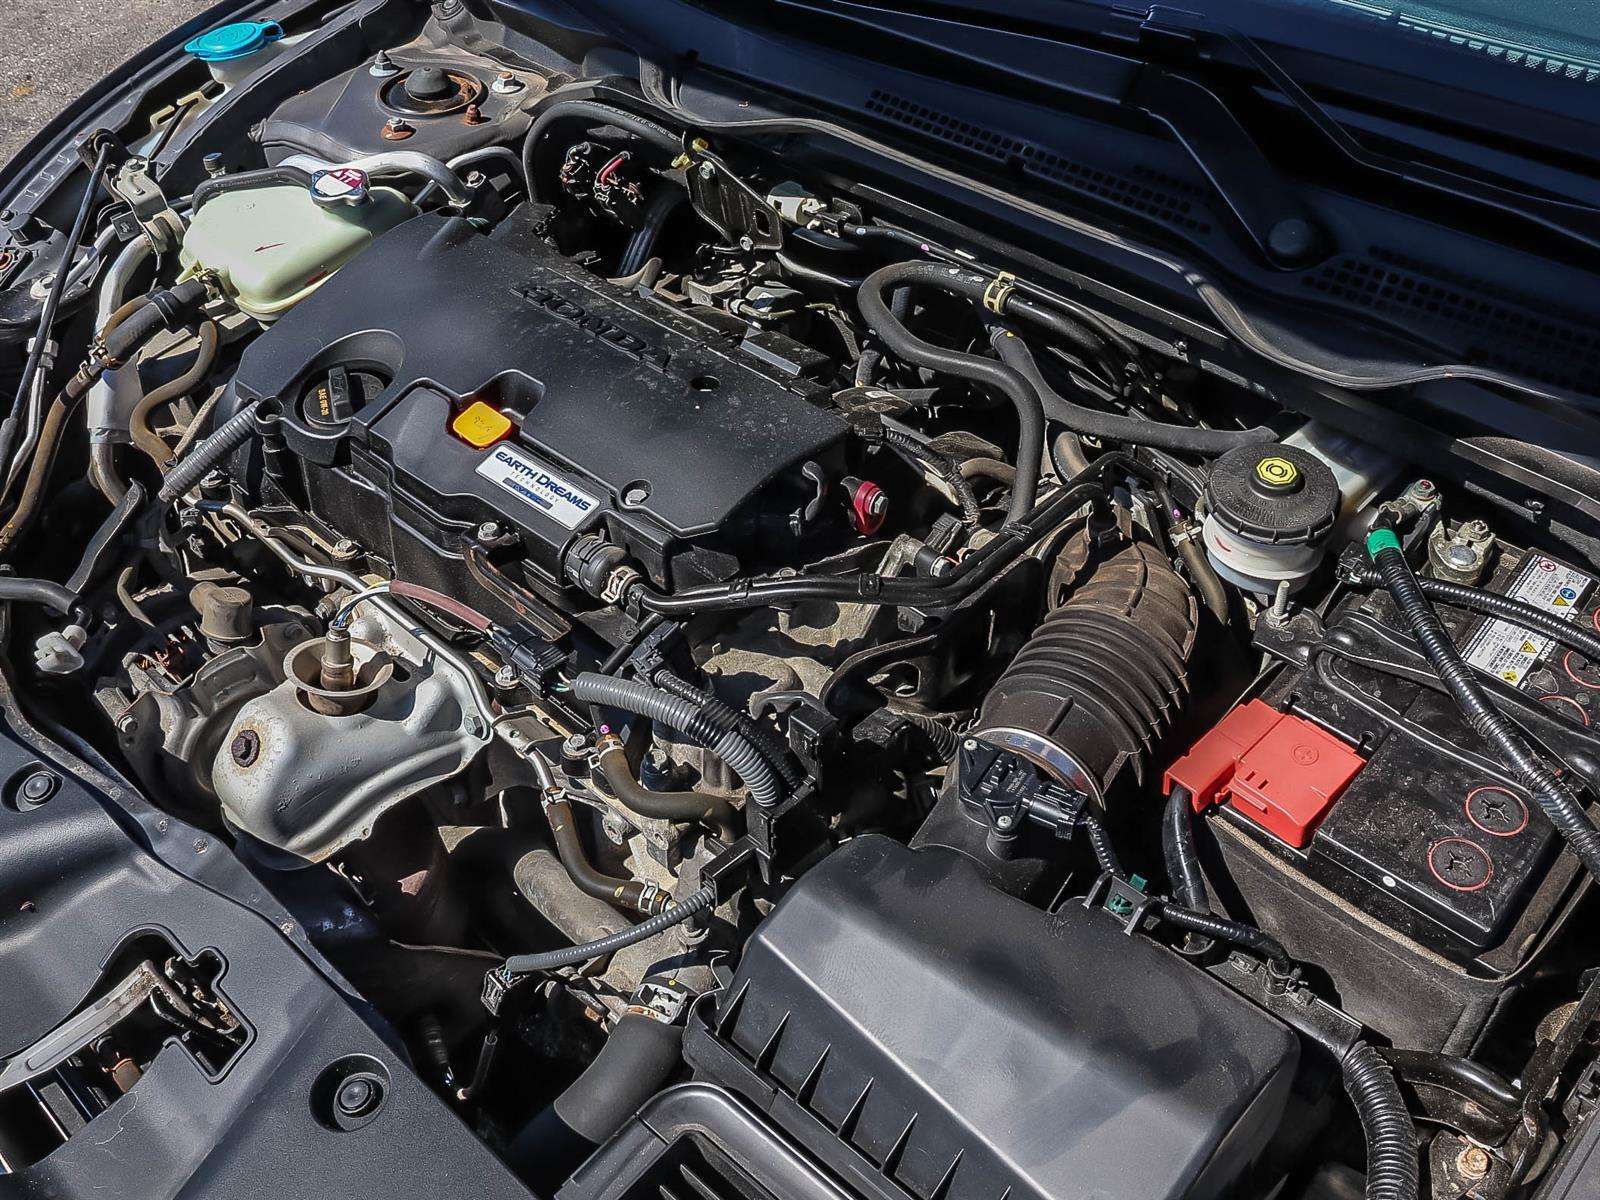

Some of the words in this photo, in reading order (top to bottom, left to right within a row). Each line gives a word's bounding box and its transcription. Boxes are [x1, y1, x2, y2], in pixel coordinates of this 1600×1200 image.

[508, 286, 674, 376] HONDA
[495, 451, 539, 479] EARTH
[535, 474, 592, 511] DREAMS
[511, 471, 559, 503] TECHNOLOGY
